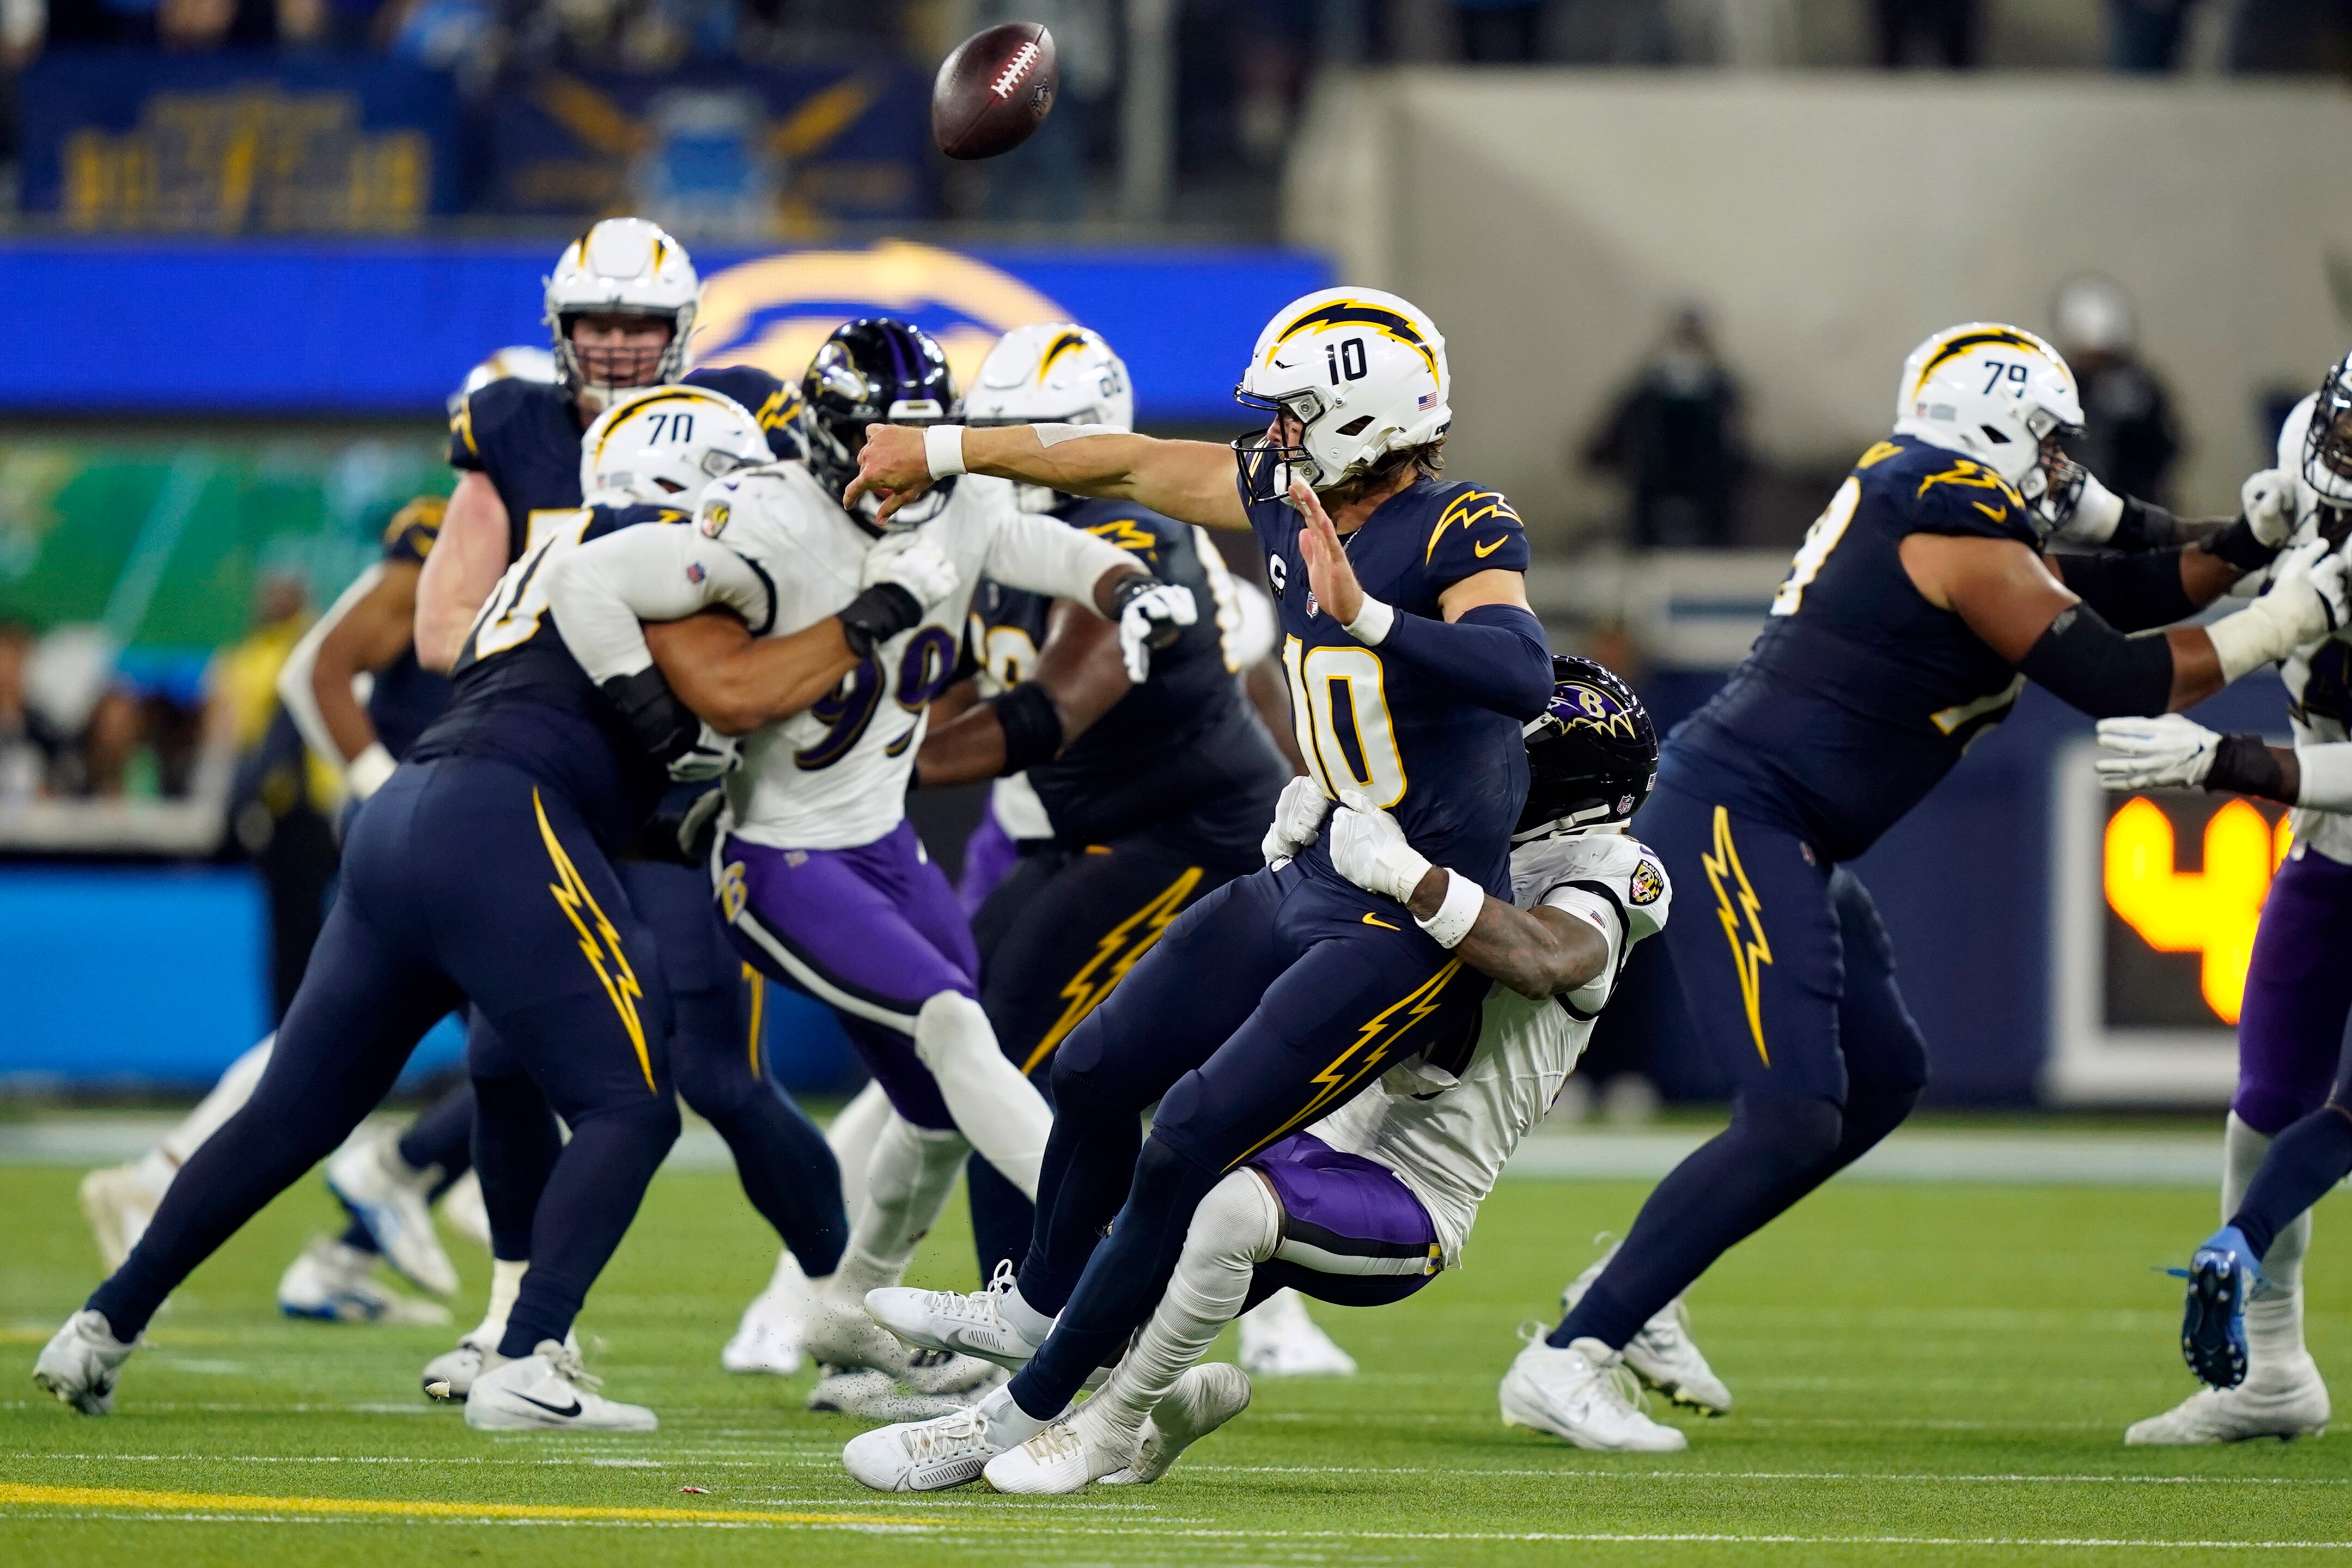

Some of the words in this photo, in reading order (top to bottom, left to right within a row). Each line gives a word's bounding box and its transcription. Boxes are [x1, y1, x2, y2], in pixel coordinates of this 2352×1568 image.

[1325, 337, 1368, 386] 10
[1983, 361, 2028, 398] 79
[648, 414, 693, 446] 70
[1270, 553, 1287, 590] C
[794, 623, 956, 771] 99
[1283, 632, 1407, 809] 10
[2103, 796, 2295, 1026] 4
